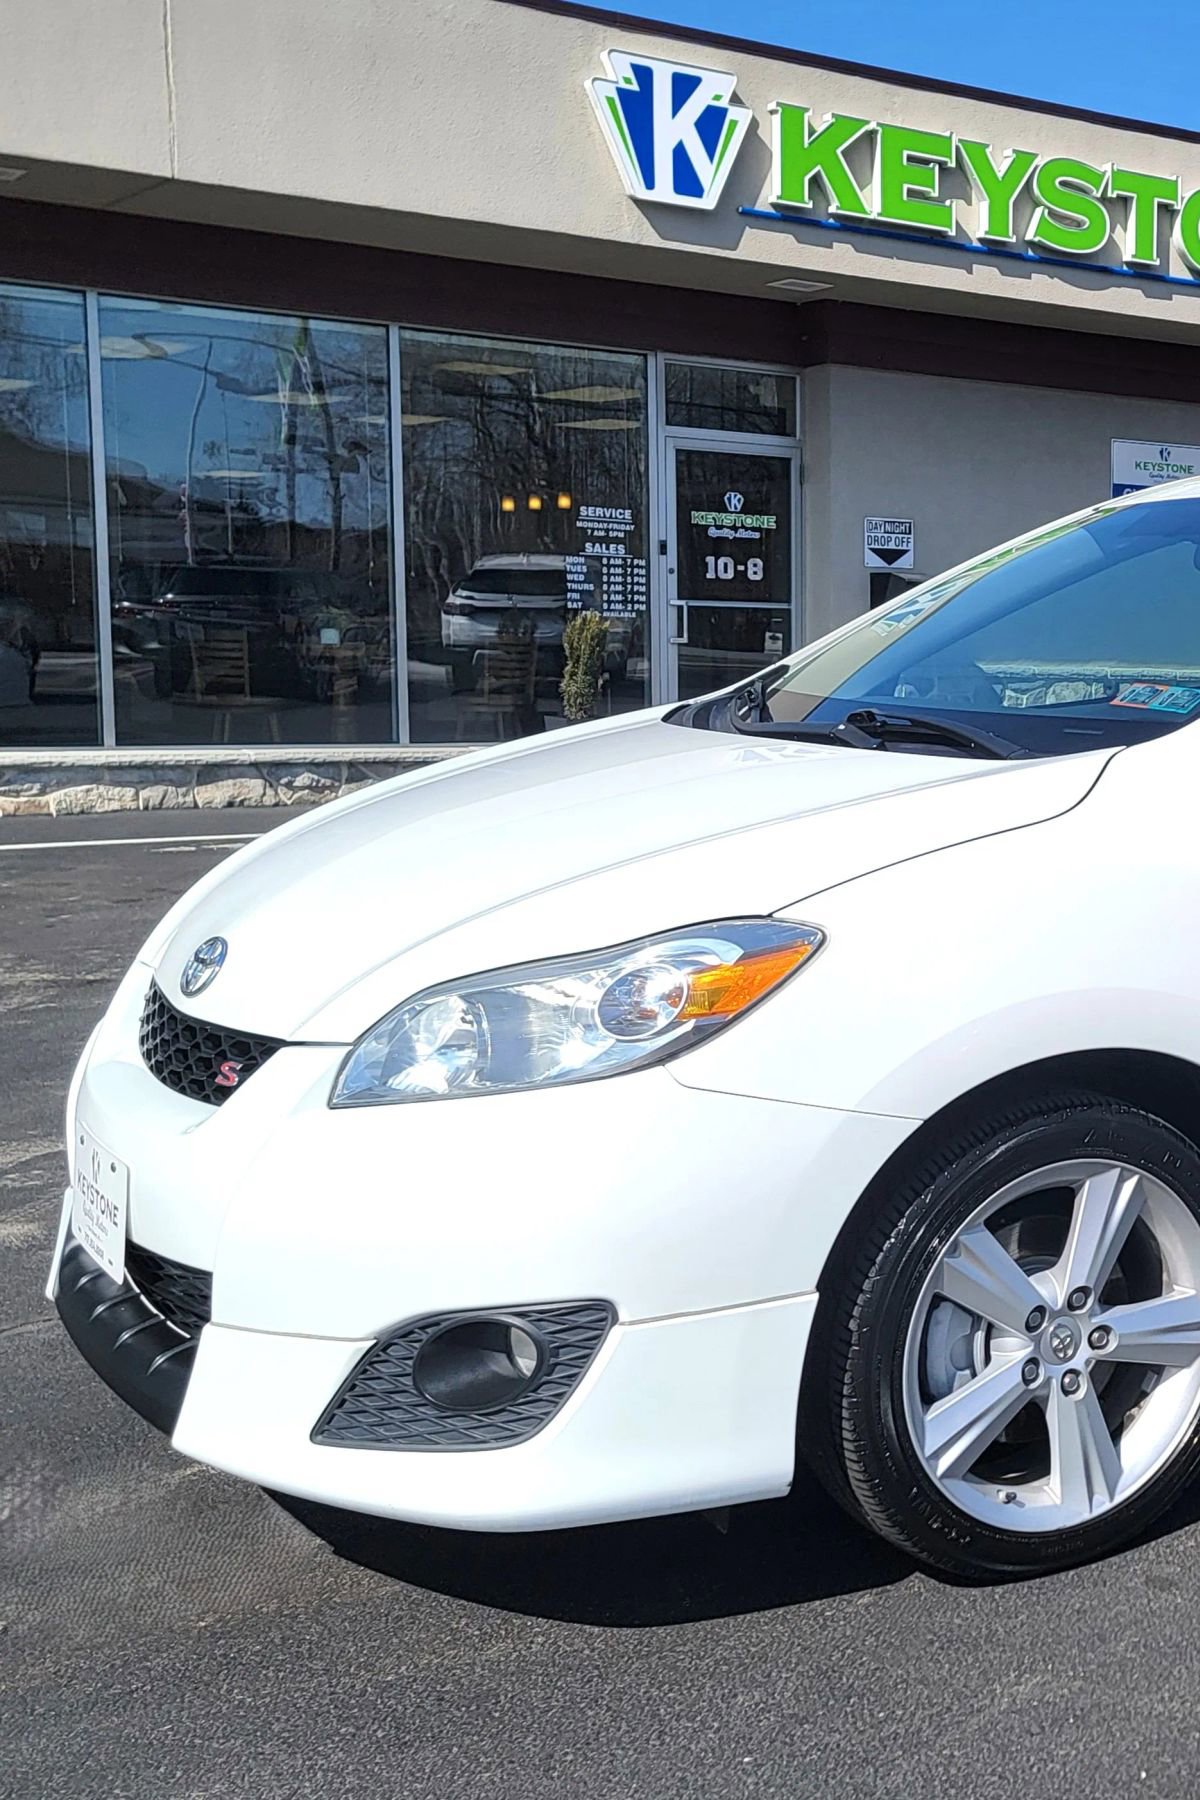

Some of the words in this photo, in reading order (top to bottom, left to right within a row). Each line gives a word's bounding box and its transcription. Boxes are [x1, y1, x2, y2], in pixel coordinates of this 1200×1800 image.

[1135, 461, 1195, 475] KEYSTONE
[579, 506, 632, 519] SERVICE
[576, 521, 636, 531] MONDAY-FRIDAY
[691, 510, 777, 529] KEYSTONE
[868, 521, 883, 532] DAY
[885, 521, 911, 534] NIGHT
[867, 534, 893, 547] DROP
[894, 536, 912, 548] OFF
[585, 542, 626, 555] SALES
[566, 555, 585, 564] MON
[566, 565, 587, 573] TUES
[566, 573, 585, 581] WED
[567, 582, 595, 591] THURS
[567, 592, 580, 600] FRI
[567, 601, 583, 609] SAT
[214, 1060, 243, 1087] S
[77, 1167, 119, 1228] KEYSTONE
